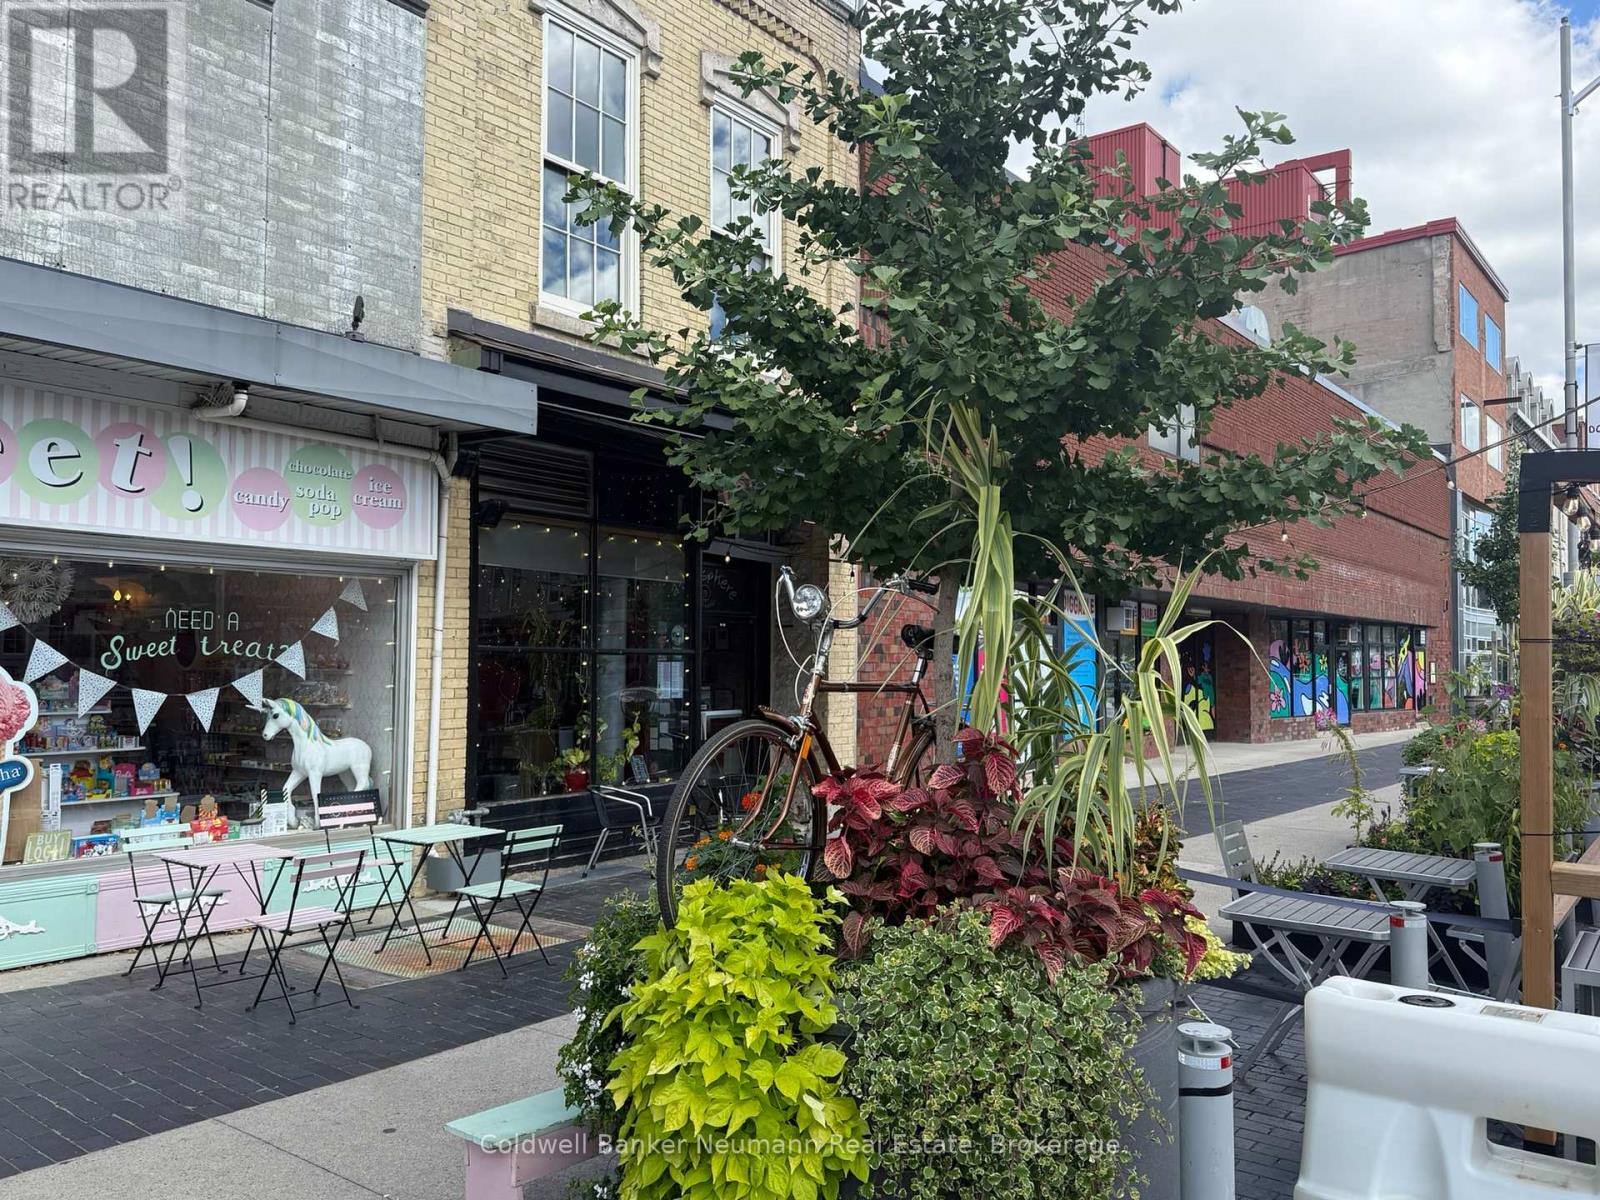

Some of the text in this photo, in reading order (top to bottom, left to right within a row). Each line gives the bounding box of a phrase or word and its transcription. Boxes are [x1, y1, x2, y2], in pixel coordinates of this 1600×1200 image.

[0, 431, 204, 512] et!
[288, 459, 353, 480] chocolate
[296, 484, 337, 502] soda
[368, 476, 393, 494] ice
[233, 490, 290, 512] candy
[309, 501, 342, 520] pop
[353, 492, 403, 510] cream
[165, 608, 239, 631] NEED A
[100, 635, 177, 671] Sweet
[37, 833, 60, 846] BUY
